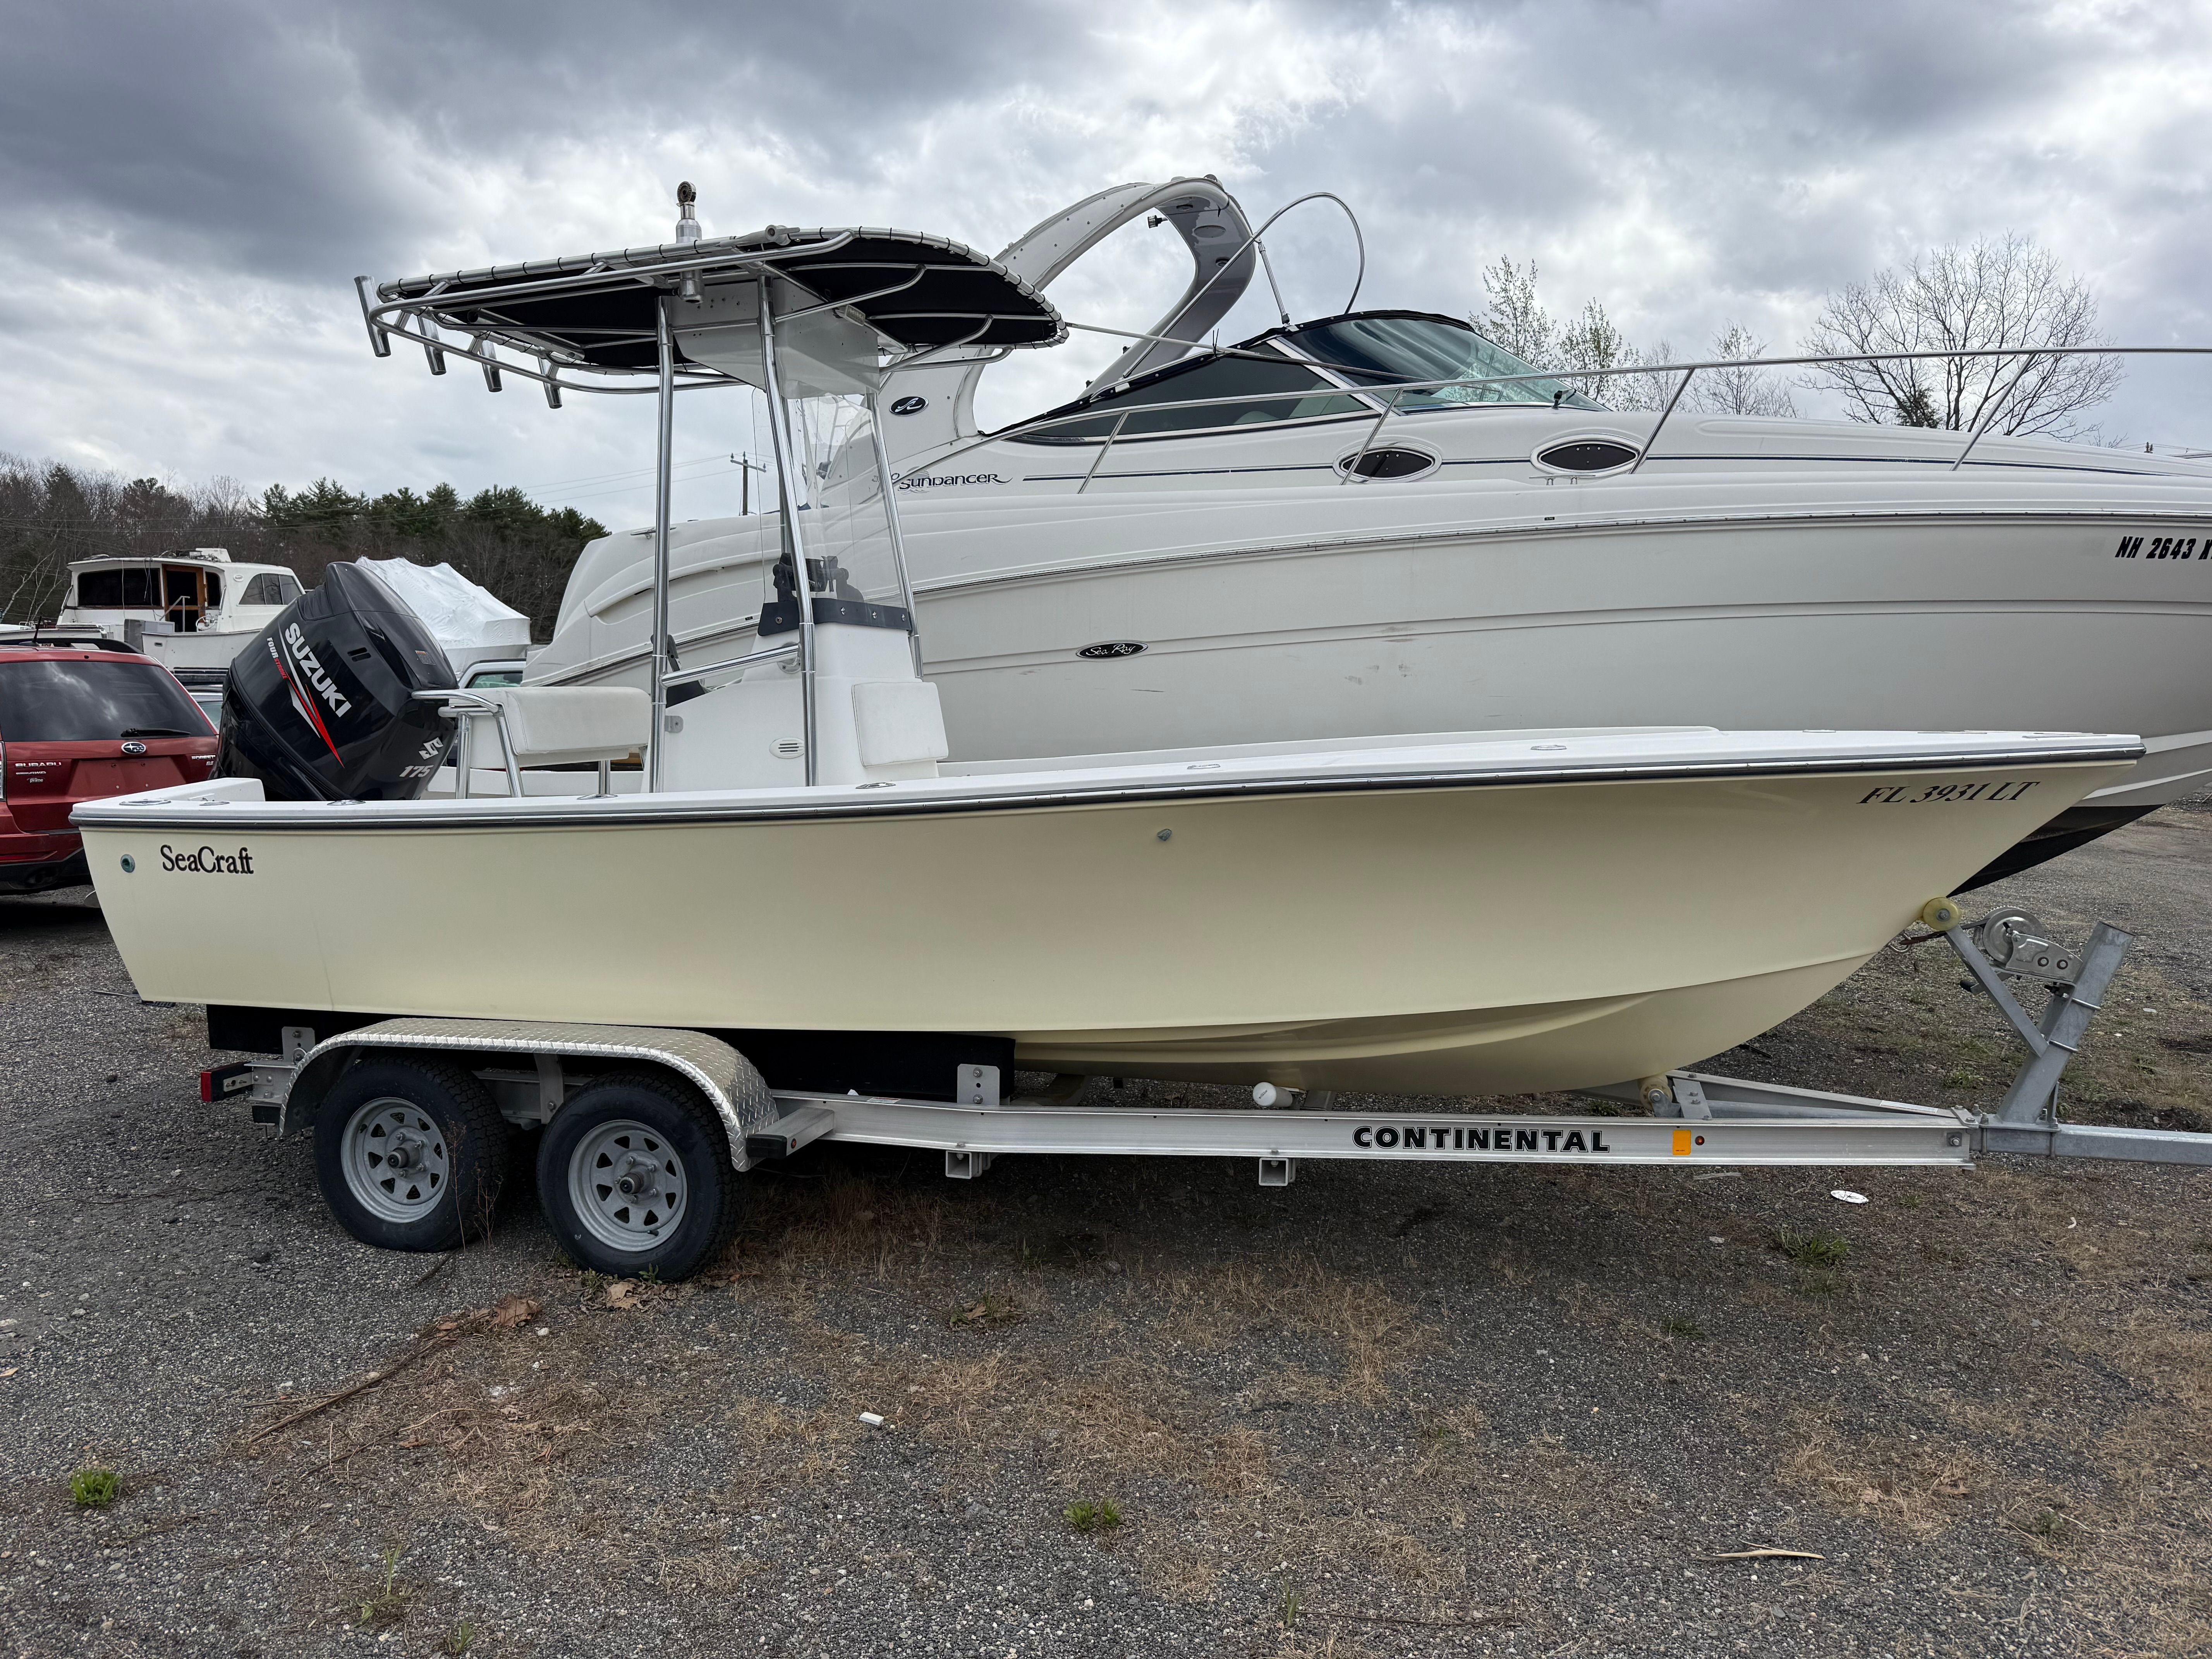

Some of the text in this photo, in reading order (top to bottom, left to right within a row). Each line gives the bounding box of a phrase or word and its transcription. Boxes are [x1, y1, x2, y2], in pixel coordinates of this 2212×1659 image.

[2115, 536, 2212, 560] NH 2643 X
[1086, 643, 1136, 656] Sea Ray
[285, 623, 352, 718] SUZUKI
[399, 765, 434, 778] 175
[1856, 781, 2041, 804] FL 3931 LT
[160, 844, 254, 874] SeaCraft
[1352, 1126, 1610, 1153] CONTINENTAL
